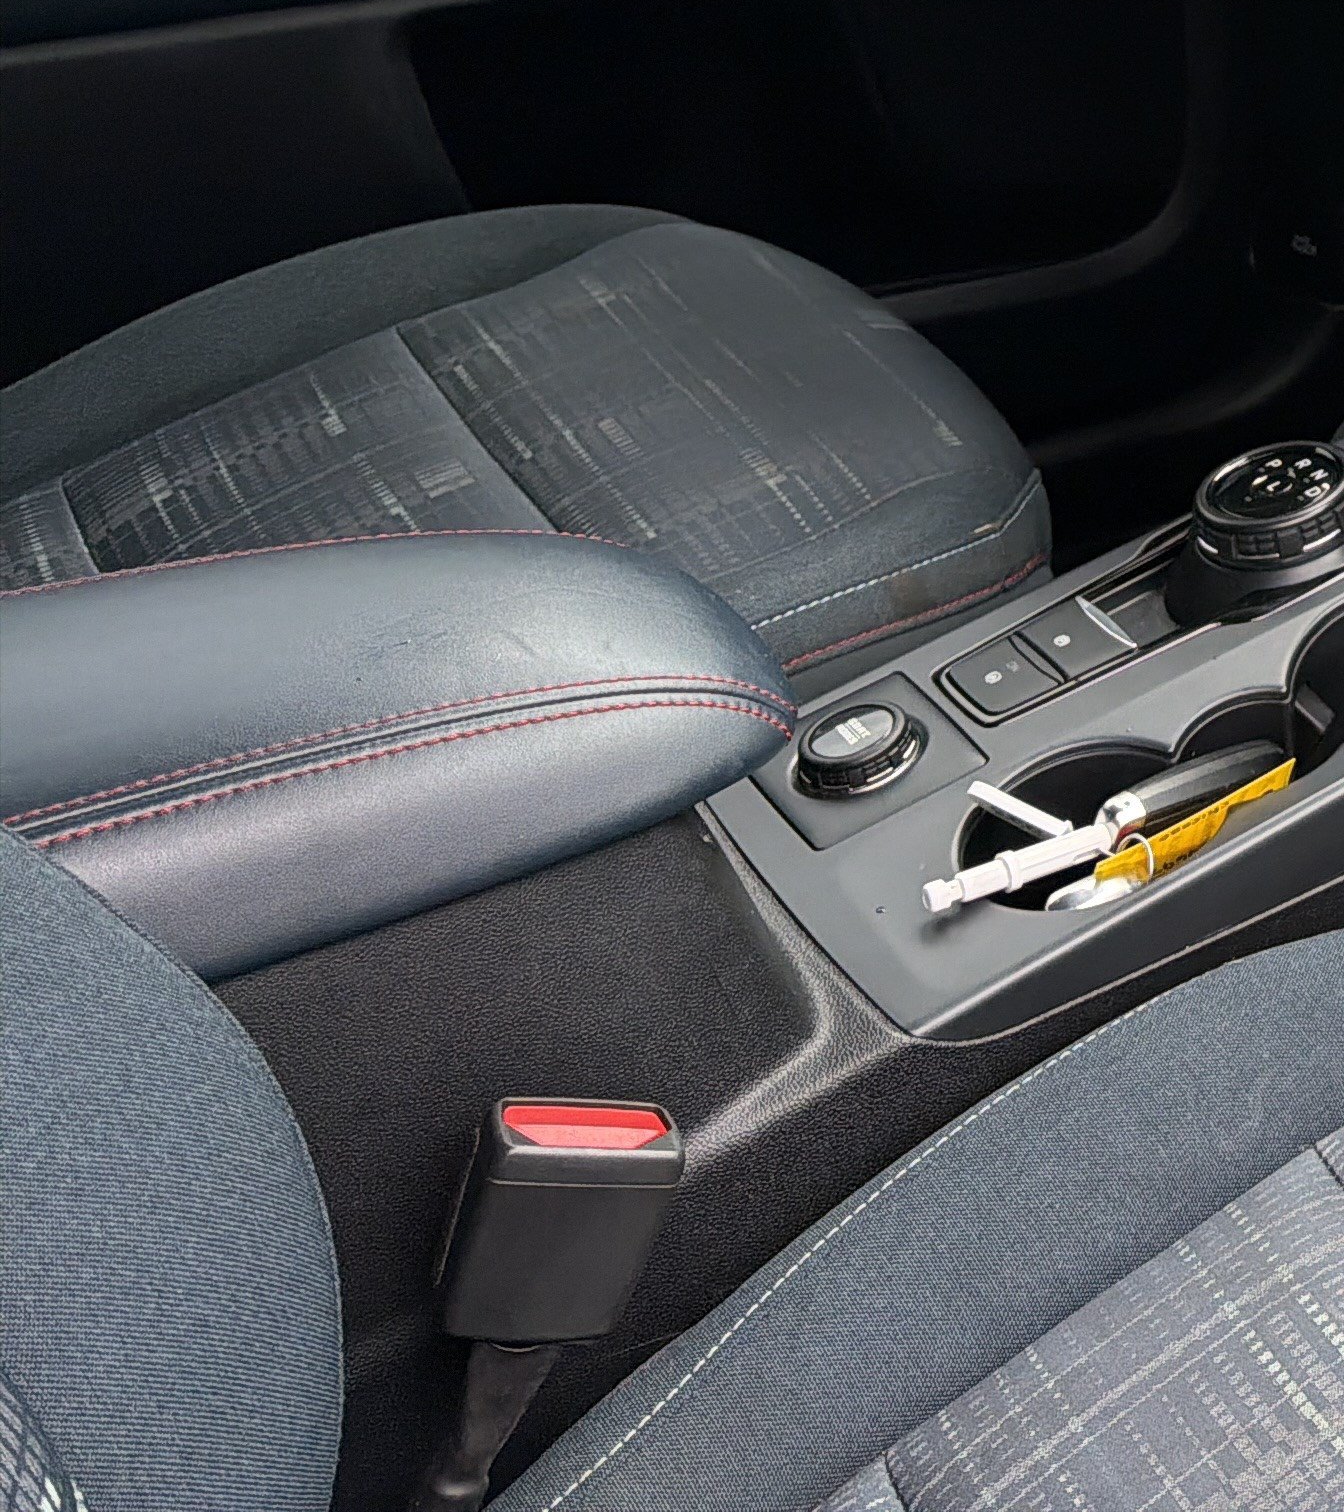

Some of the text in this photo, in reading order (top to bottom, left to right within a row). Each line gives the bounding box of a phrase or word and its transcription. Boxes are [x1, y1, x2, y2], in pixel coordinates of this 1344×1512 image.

[1265, 458, 1283, 468] P
[1295, 458, 1312, 469] R
[1310, 469, 1329, 480] N
